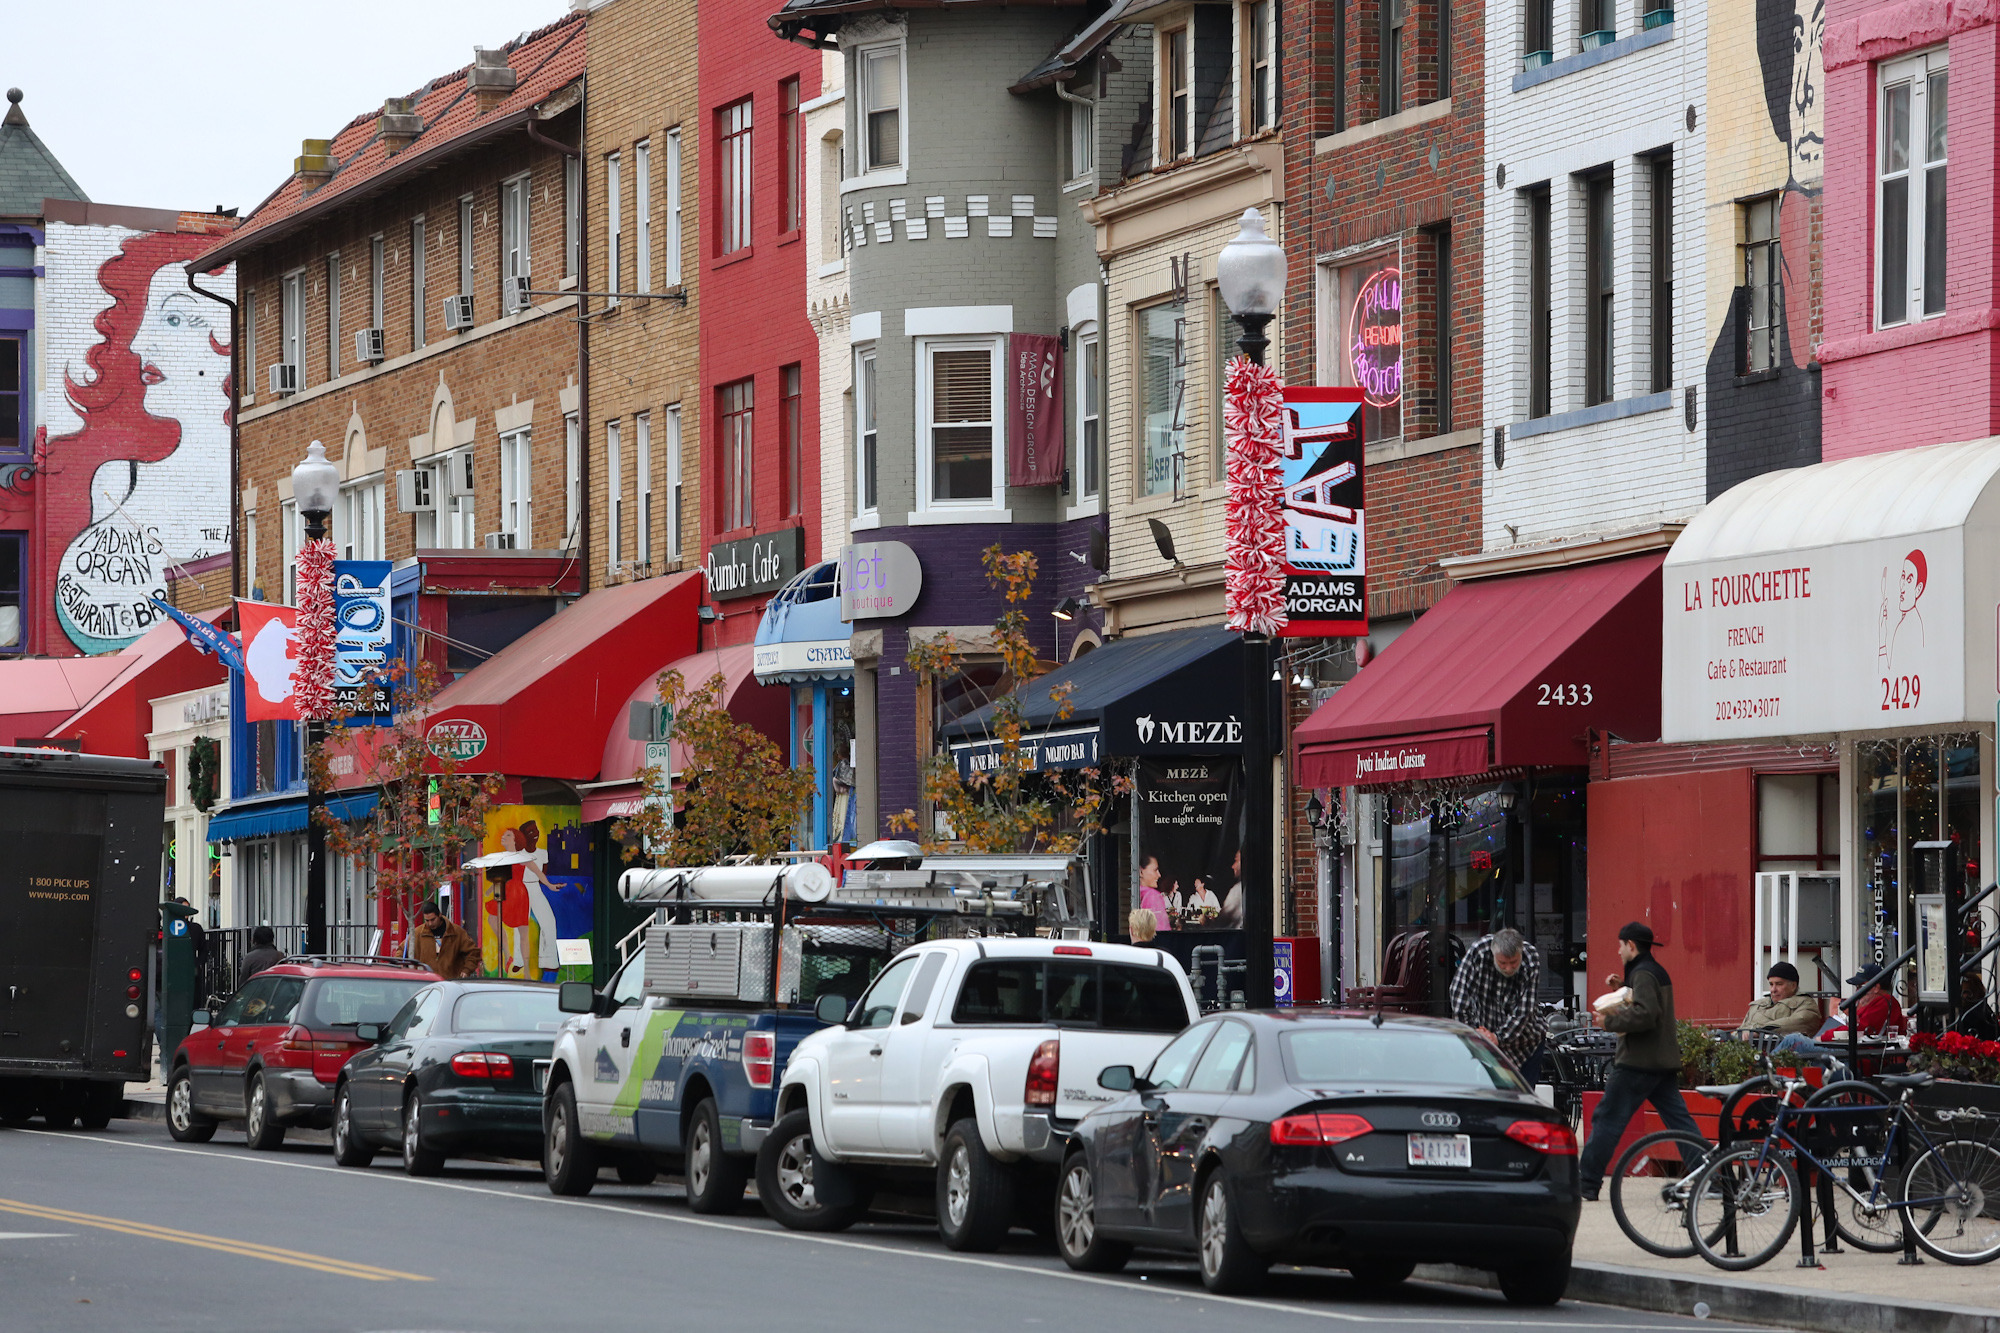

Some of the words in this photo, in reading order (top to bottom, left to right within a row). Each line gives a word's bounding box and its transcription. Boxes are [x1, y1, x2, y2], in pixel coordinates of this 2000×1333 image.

[1364, 279, 1401, 320] PALM
[1364, 323, 1402, 347] READIN
[1020, 351, 1028, 369] Idea
[1027, 351, 1037, 387] MAGA
[1026, 388, 1036, 430] DESIGN
[1026, 432, 1037, 471] GROUP
[1281, 407, 1358, 571] EAT
[76, 551, 152, 586] ORGAN
[708, 547, 747, 593] Rumba
[752, 539, 780, 584] Cafe
[1287, 581, 1356, 596] ADAMS
[1684, 580, 1703, 612] LA
[1711, 567, 1811, 608] FOURCHETTE
[58, 573, 120, 636] RESTAURANT
[852, 594, 893, 612] boutique
[1284, 598, 1363, 613] MORGAN
[335, 573, 388, 685] SHOP
[1727, 625, 1764, 647] FRENCH
[1707, 658, 1727, 680] Cafe
[1728, 658, 1737, 678] &
[1738, 656, 1787, 677] Restaurant
[1536, 683, 1594, 707] 2433
[1881, 674, 1921, 711] 2429
[435, 725, 482, 739] PIZZA
[1159, 715, 1243, 743] MEZÈ
[969, 755, 987, 772] WINE
[987, 752, 1000, 770] BAR
[1070, 742, 1086, 762] BAR
[1355, 752, 1374, 779] Jyoti
[1374, 750, 1398, 771] Indian
[1398, 748, 1426, 770] Cuisine
[1166, 765, 1209, 779] MEZÈ
[630, 799, 645, 815] CAF
[1148, 790, 1196, 803] Kitchen
[1199, 792, 1228, 805] open
[1181, 803, 1195, 815] for
[1154, 814, 1171, 824] late
[1172, 814, 1194, 826] night
[1196, 813, 1223, 826] dining
[36, 877, 52, 887] 800
[53, 878, 72, 888] PICK
[73, 879, 90, 889] UPS
[28, 891, 90, 902] www.ups.com
[174, 919, 186, 936] P
[1345, 1152, 1365, 1163] A4
[1817, 1156, 1850, 1168] ADAMS
